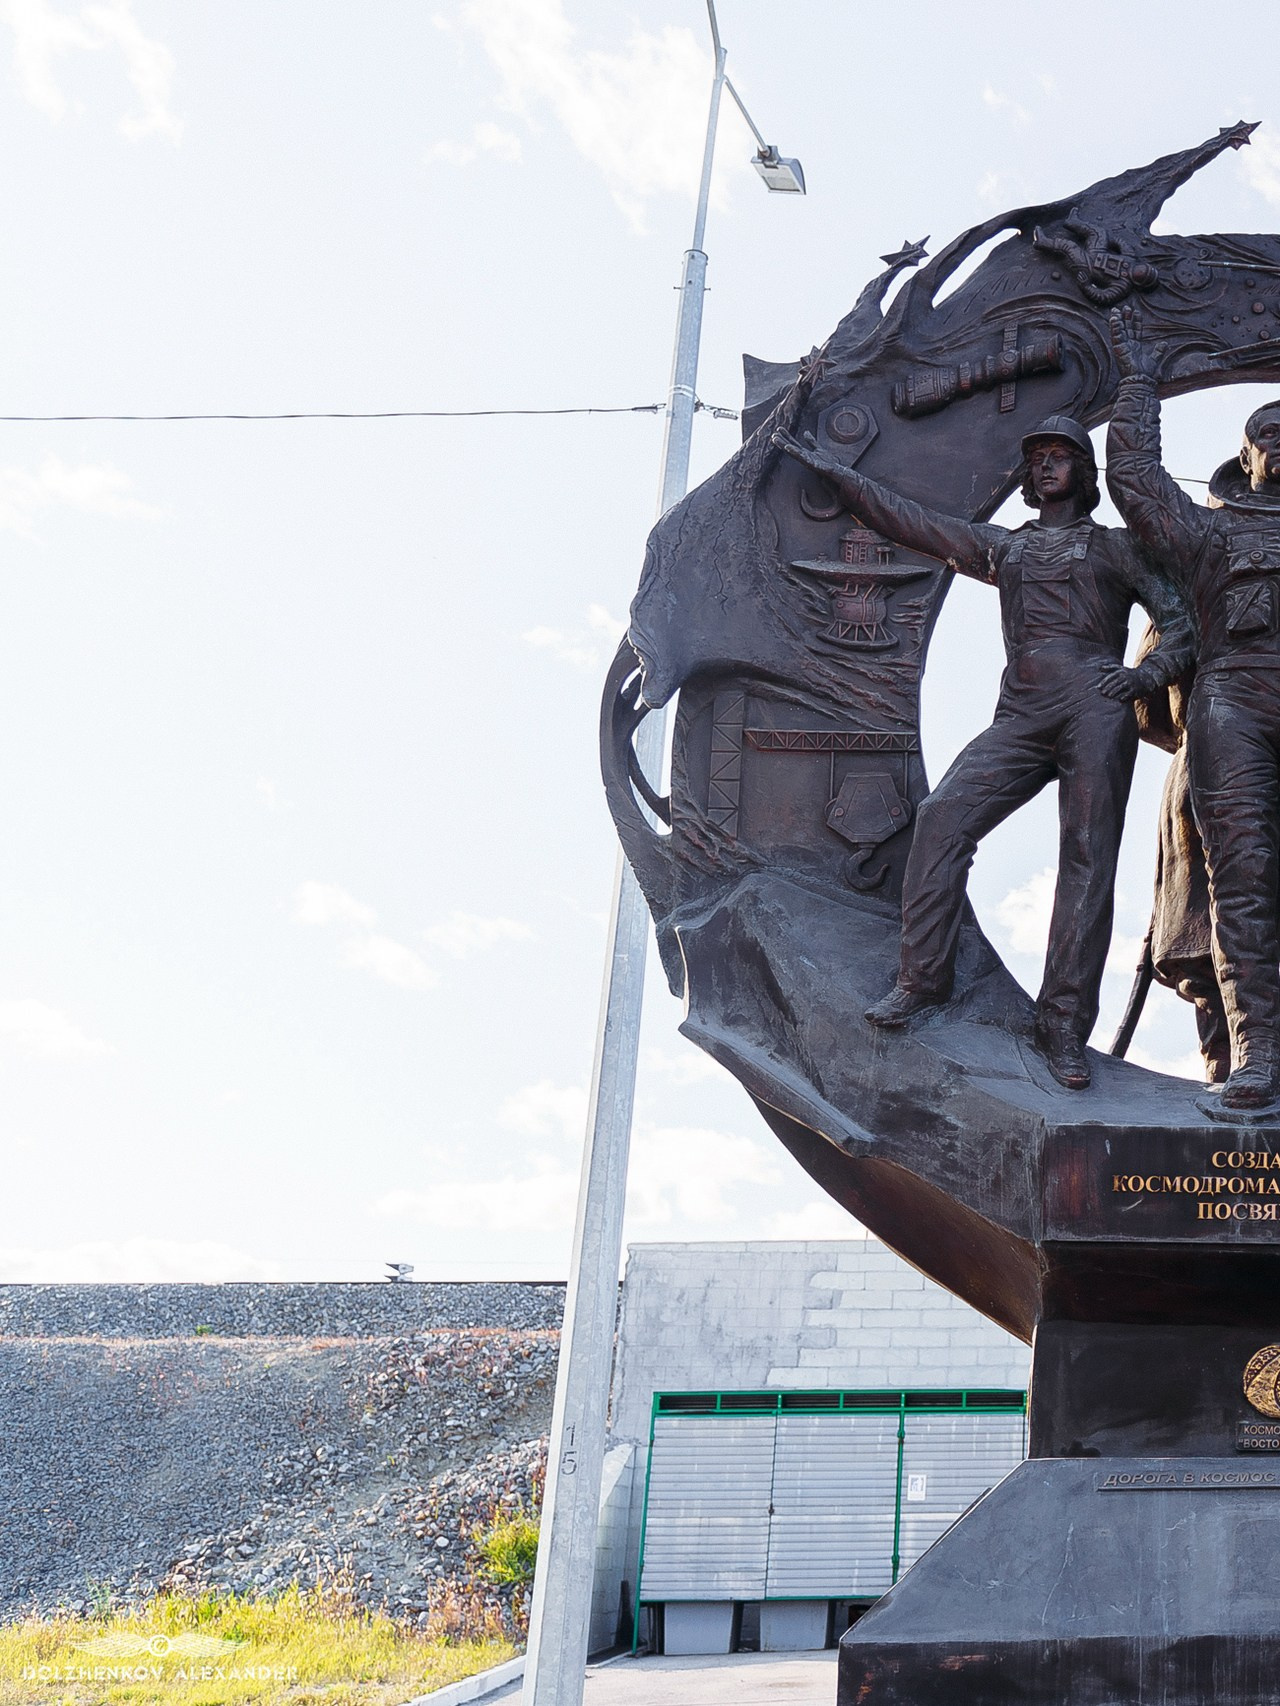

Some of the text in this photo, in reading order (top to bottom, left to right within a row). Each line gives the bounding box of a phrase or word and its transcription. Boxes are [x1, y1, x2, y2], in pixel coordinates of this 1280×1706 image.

[1112, 1175, 1280, 1196] КОСМОДРОМА
[1104, 1473, 1177, 1486] ДОРОГА
[1183, 1472, 1195, 1483] В
[1200, 1471, 1276, 1483] КОСМОС
